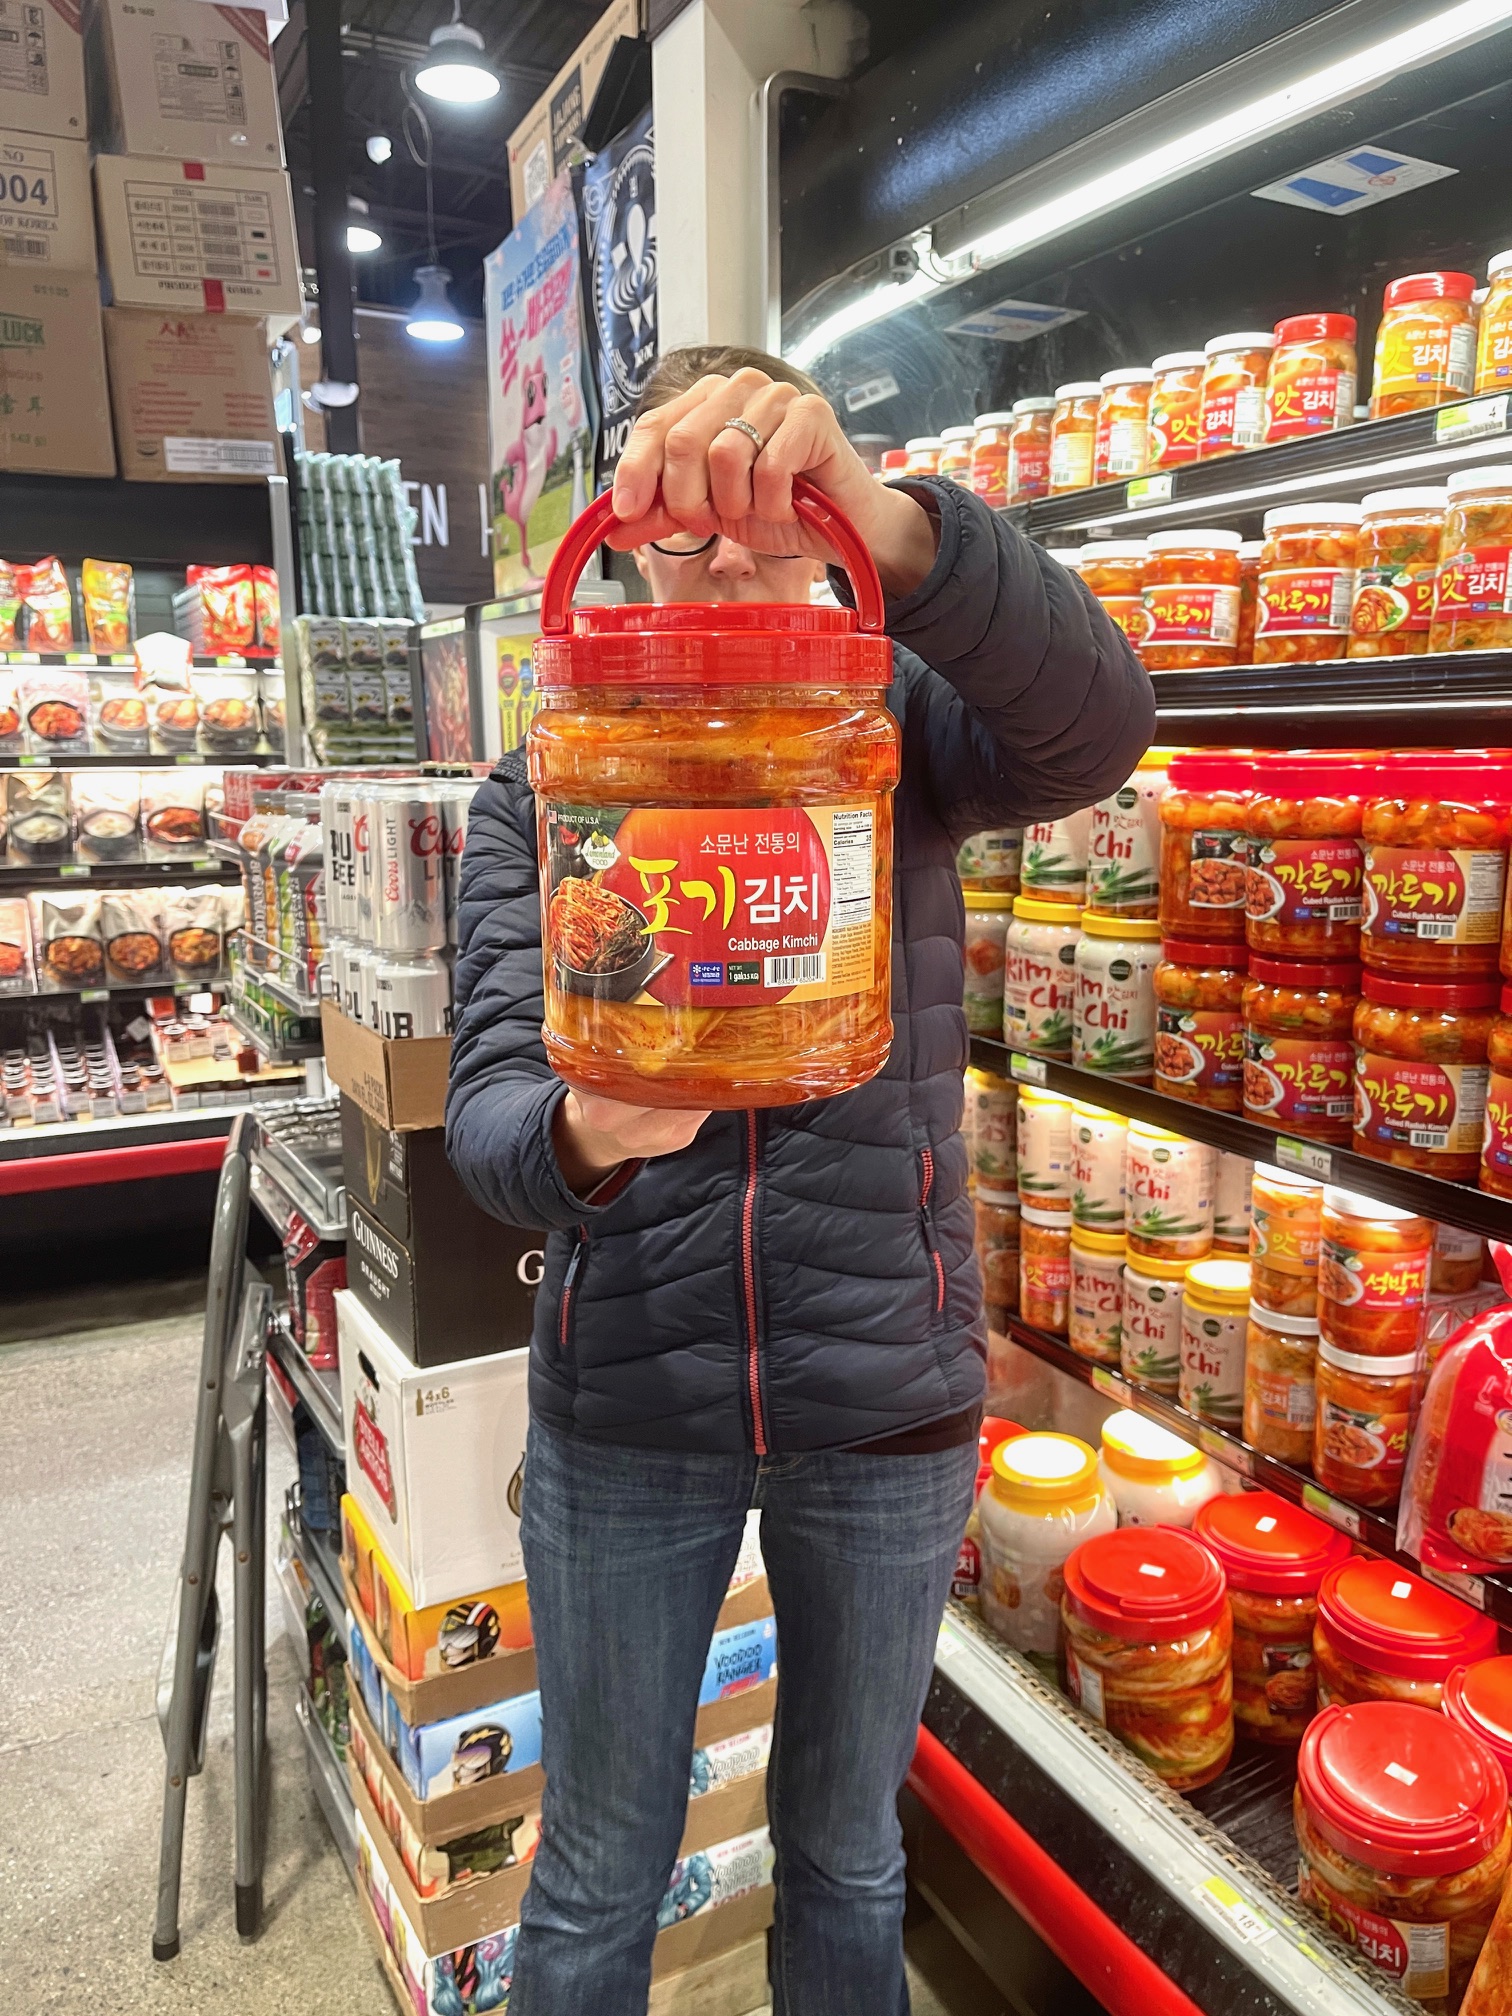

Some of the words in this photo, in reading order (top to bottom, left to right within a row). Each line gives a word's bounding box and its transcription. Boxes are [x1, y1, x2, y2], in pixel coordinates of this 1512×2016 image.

[1413, 344, 1448, 366] 김치
[1274, 384, 1303, 418] 맛
[1302, 390, 1335, 411] 김치
[1206, 409, 1233, 431] 김치
[1467, 574, 1504, 595] 김치
[1266, 589, 1330, 613] 깍두기
[558, 814, 578, 824] PRODUCT
[577, 816, 585, 824] OF
[387, 819, 398, 859] LIGHT
[700, 836, 749, 856] 소문난
[754, 831, 801, 856] 전통의
[1094, 829, 1134, 860] Chi
[1273, 859, 1362, 895] 깍두기
[1371, 868, 1457, 909] 깍두기
[743, 873, 819, 924] 김치
[728, 937, 780, 953] Cabbage
[782, 933, 818, 949] Kimchi
[1084, 1000, 1129, 1031] Chi
[1363, 1076, 1448, 1118] 깍두기
[1134, 1179, 1171, 1200] Chi
[353, 1210, 399, 1279] GUINNESS
[1131, 1316, 1166, 1341] Chi
[1186, 1351, 1222, 1377] Chi
